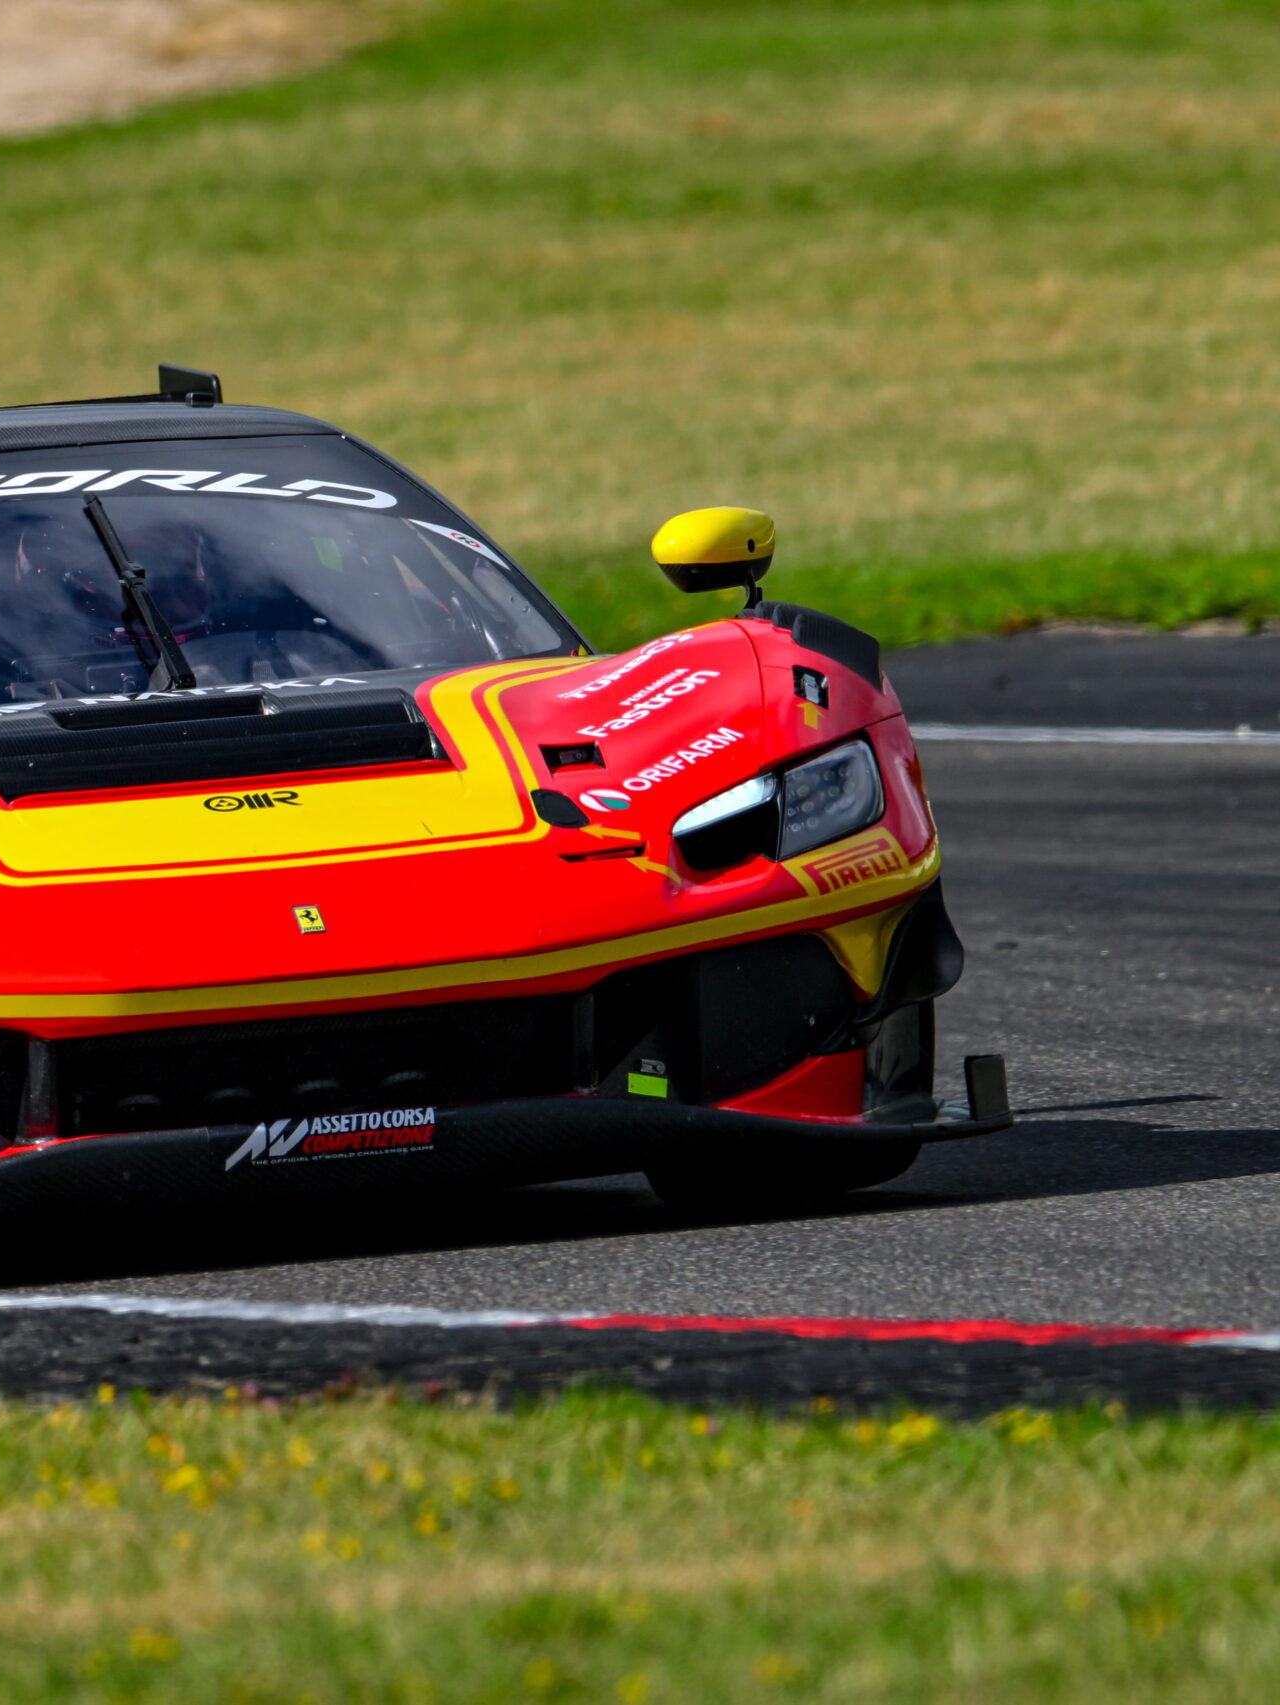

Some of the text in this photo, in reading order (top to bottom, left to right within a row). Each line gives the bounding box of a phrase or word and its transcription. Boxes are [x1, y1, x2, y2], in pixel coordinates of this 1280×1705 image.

[577, 670, 721, 738] Fastron
[622, 727, 745, 791] ORIFARM
[800, 838, 903, 896] PIRELLI
[302, 1125, 437, 1154] COMPETIZIONE
[310, 1107, 436, 1135] ASSETTO CORSA
[251, 1158, 269, 1166] THE
[270, 1156, 310, 1165] OFFICIAL
[357, 1147, 409, 1157] CHALLENGE
[410, 1144, 435, 1152] GAME
